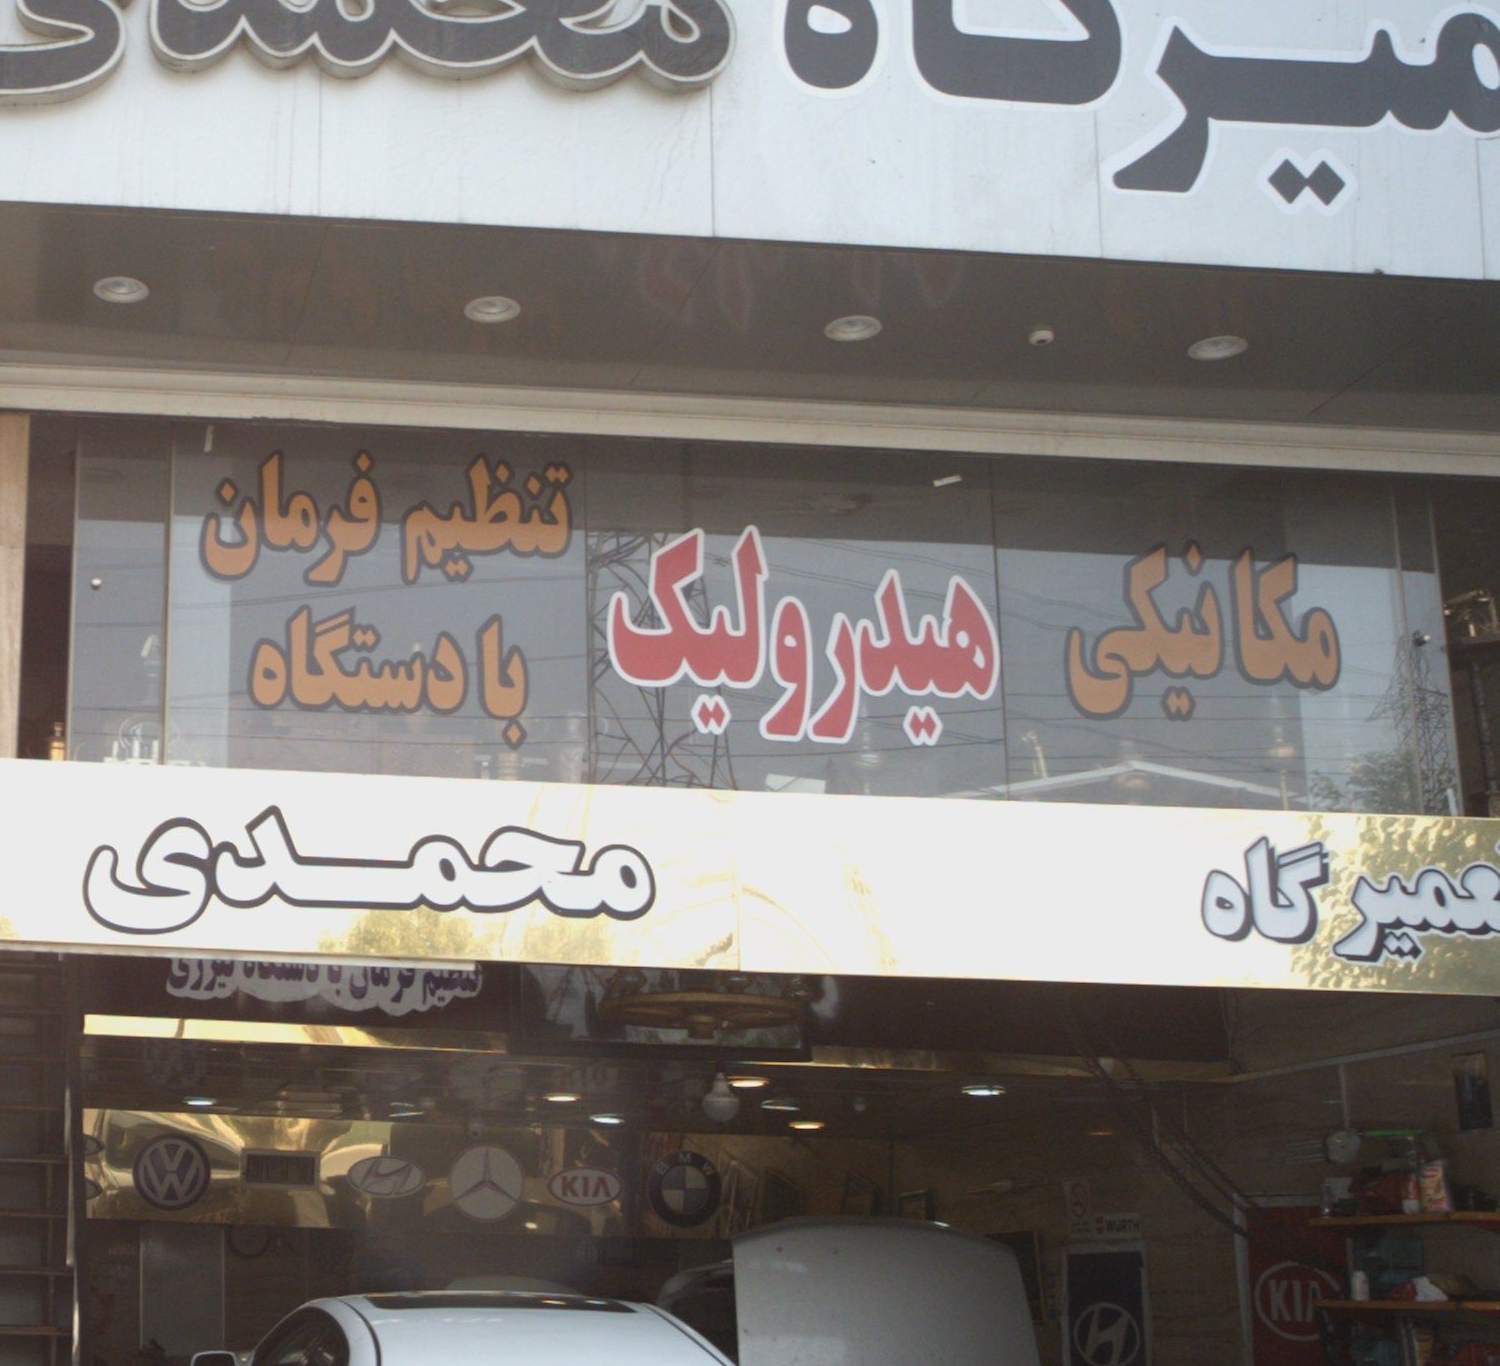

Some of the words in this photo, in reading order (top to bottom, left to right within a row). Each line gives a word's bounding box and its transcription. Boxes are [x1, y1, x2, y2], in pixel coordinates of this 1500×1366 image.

[200, 449, 382, 587] فرمان
[401, 453, 573, 585] تنظیم
[248, 603, 468, 710] دستگاه
[476, 613, 528, 750] با
[608, 525, 1000, 744] هیدرولیک
[83, 805, 656, 935] محمدی
[561, 1176, 612, 1198] KIA
[654, 1152, 714, 1176] BMW
[1267, 1278, 1329, 1323] KIA
